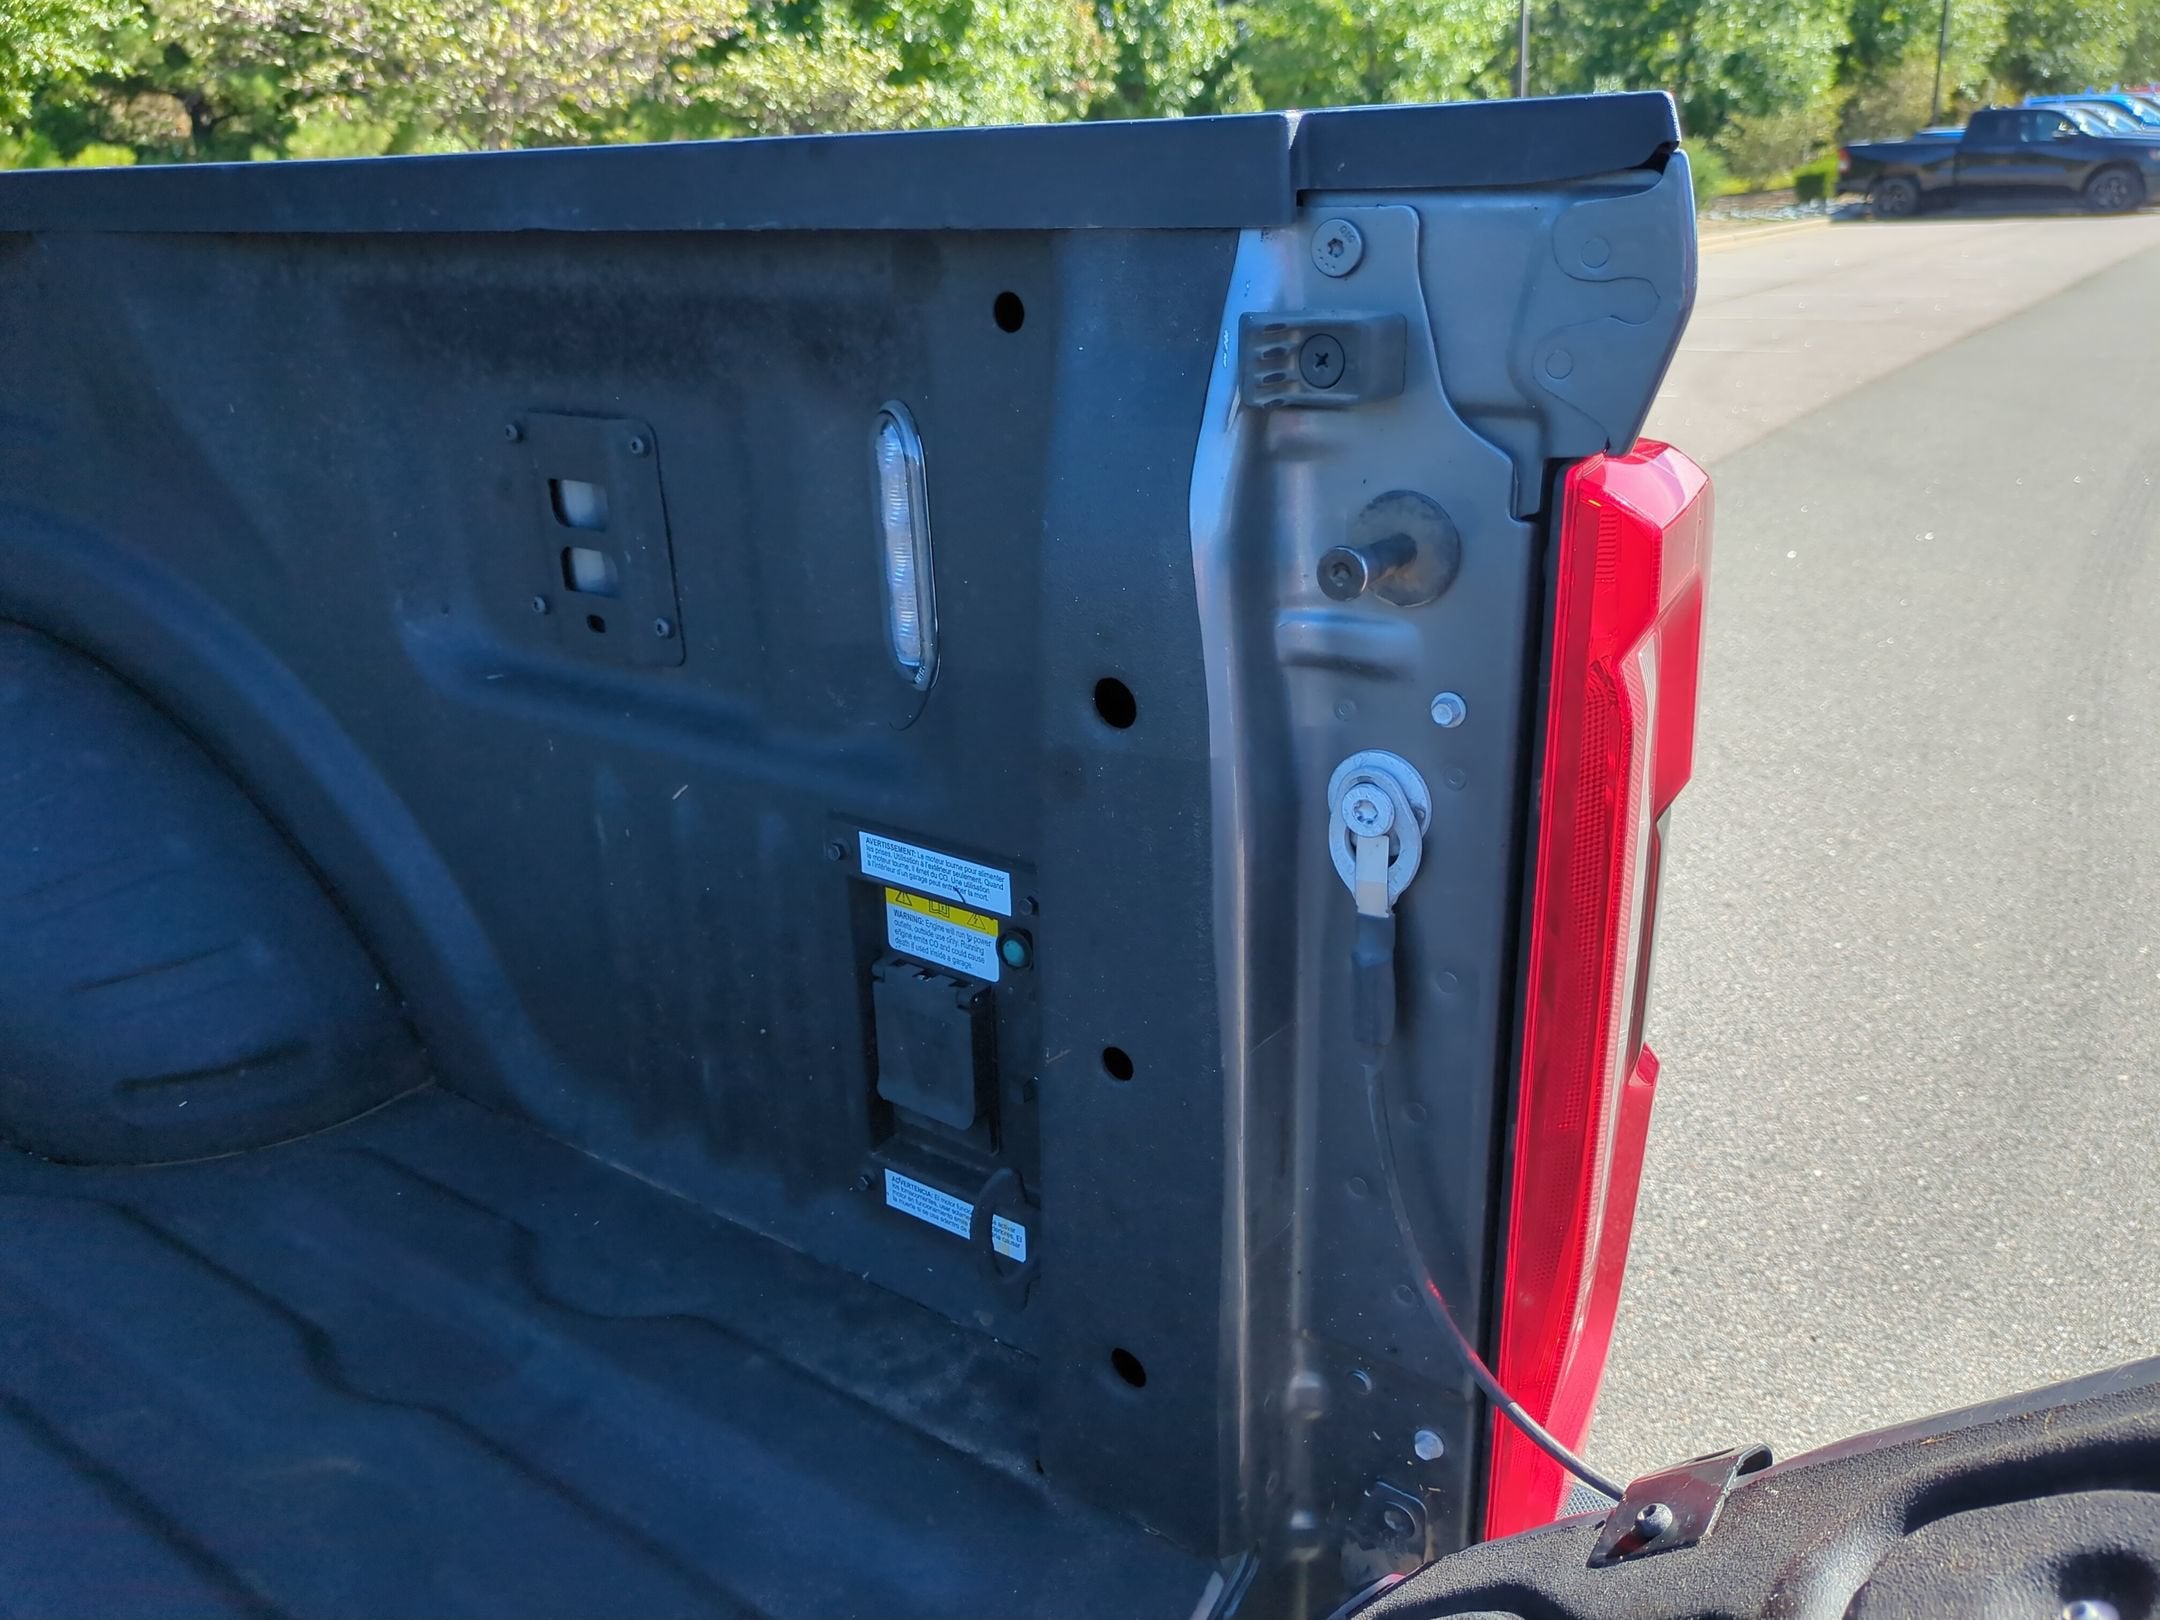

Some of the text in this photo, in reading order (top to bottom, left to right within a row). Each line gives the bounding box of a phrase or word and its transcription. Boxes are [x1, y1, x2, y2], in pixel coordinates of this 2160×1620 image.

[866, 837, 917, 857] AVERTISSEMENT:
[918, 851, 924, 860] Le
[925, 854, 944, 866] moteur
[964, 866, 976, 876] pour
[873, 855, 891, 865] moteur
[951, 876, 962, 886] Une
[909, 873, 928, 885] garage
[984, 878, 1004, 891] Quand
[893, 908, 924, 926] WARNING:
[925, 919, 944, 932] Engine
[945, 926, 956, 936] will
[973, 936, 992, 948] power
[914, 926, 935, 939] outside
[935, 933, 945, 942] use
[960, 939, 985, 956] Running
[894, 928, 912, 940] engine
[929, 938, 939, 949] CO
[939, 943, 951, 953] and
[951, 947, 967, 958] could
[967, 952, 985, 965] cause
[894, 936, 910, 947] death
[915, 944, 929, 955] used
[929, 947, 946, 961] inside
[892, 1175, 934, 1198] ADVERTENCIA:
[934, 1193, 941, 1202] El
[941, 1198, 956, 1208] motor
[929, 1212, 939, 1222] usa
[1015, 1234, 1023, 1243] El
